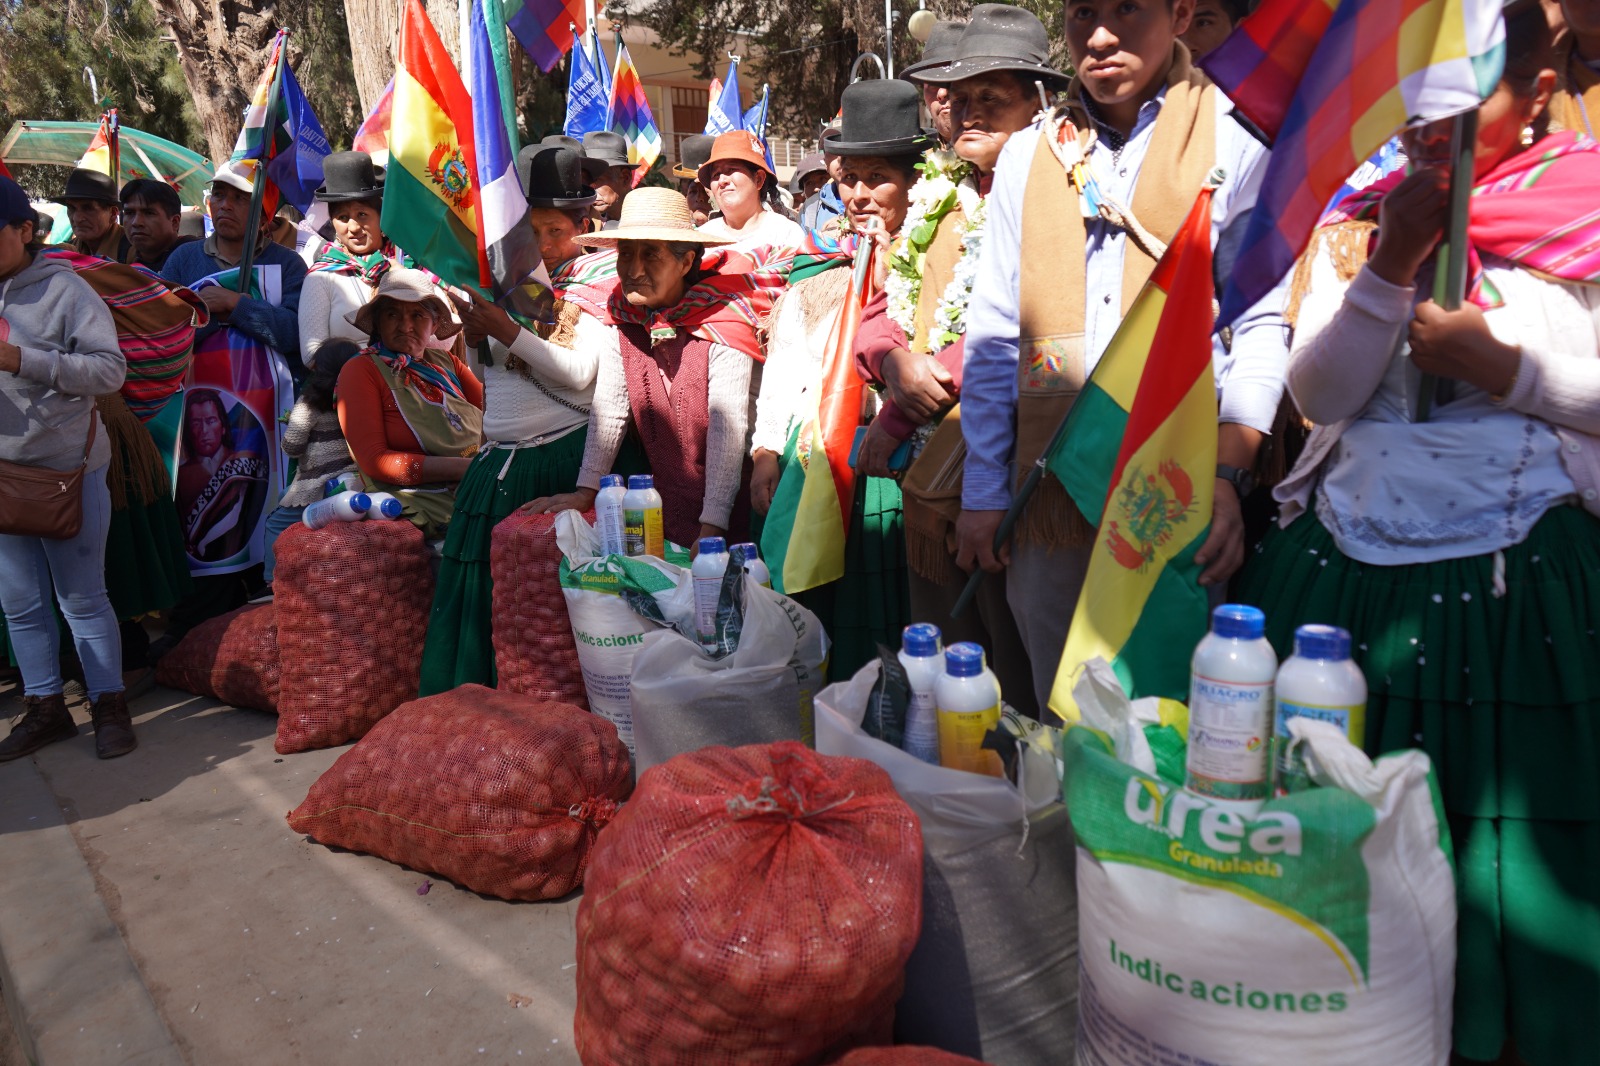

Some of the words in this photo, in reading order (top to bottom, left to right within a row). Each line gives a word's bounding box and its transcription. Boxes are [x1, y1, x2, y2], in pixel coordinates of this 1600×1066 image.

[581, 573, 618, 584] Granulada
[573, 627, 644, 648] Indicacione
[1124, 776, 1301, 856] urea
[1169, 841, 1283, 878] Granulada
[1110, 939, 1348, 1013] Indicaciones
